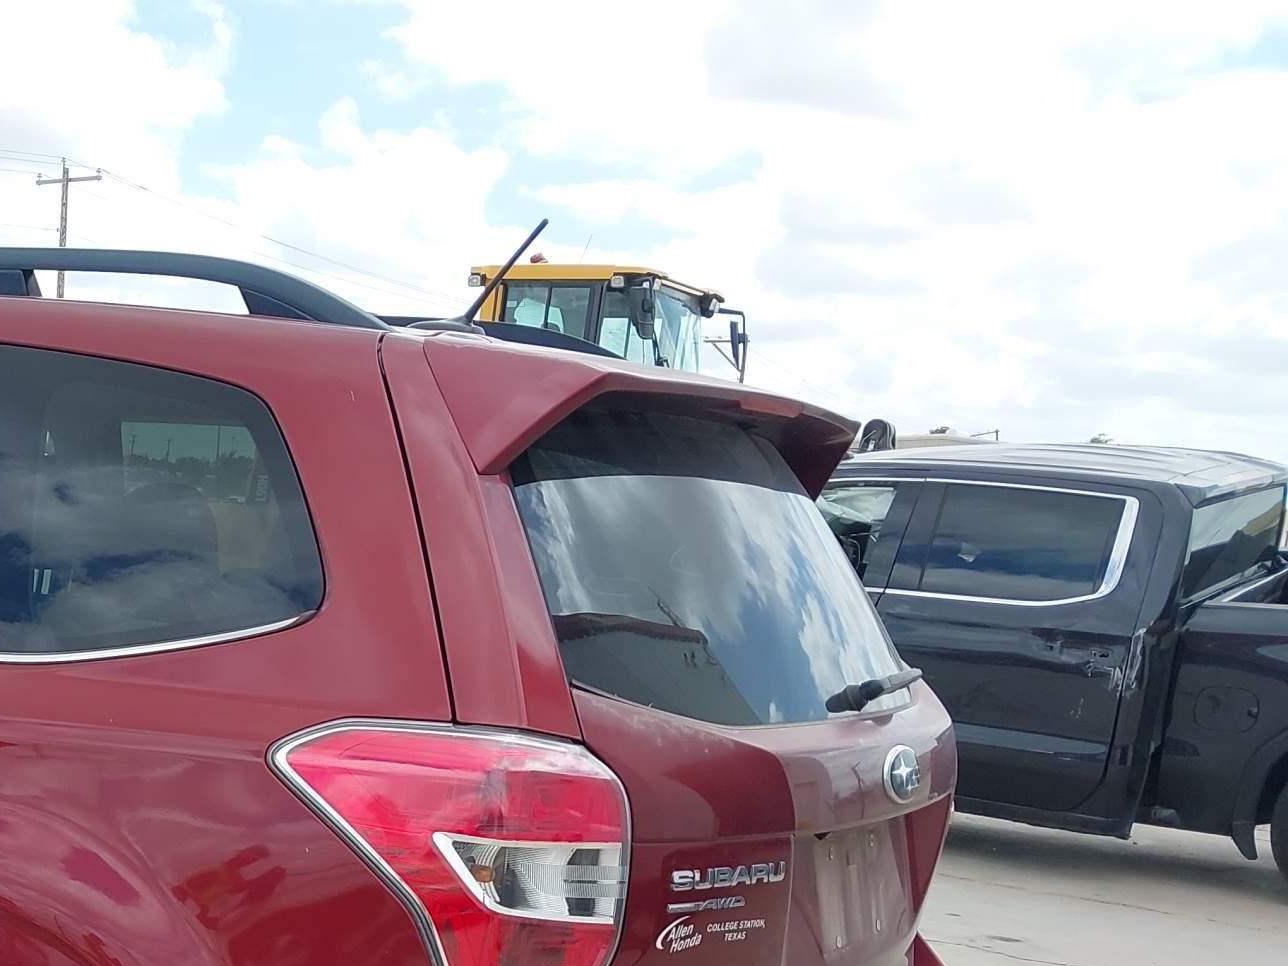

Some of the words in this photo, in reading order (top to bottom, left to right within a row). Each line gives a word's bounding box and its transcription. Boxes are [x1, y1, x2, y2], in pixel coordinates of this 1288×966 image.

[672, 861, 785, 891] SUBARU
[703, 896, 745, 911] AWD
[667, 924, 694, 942] Allen
[707, 921, 739, 932] COLLEGE
[670, 933, 702, 953] Honda
[725, 931, 746, 942] TEXAS
